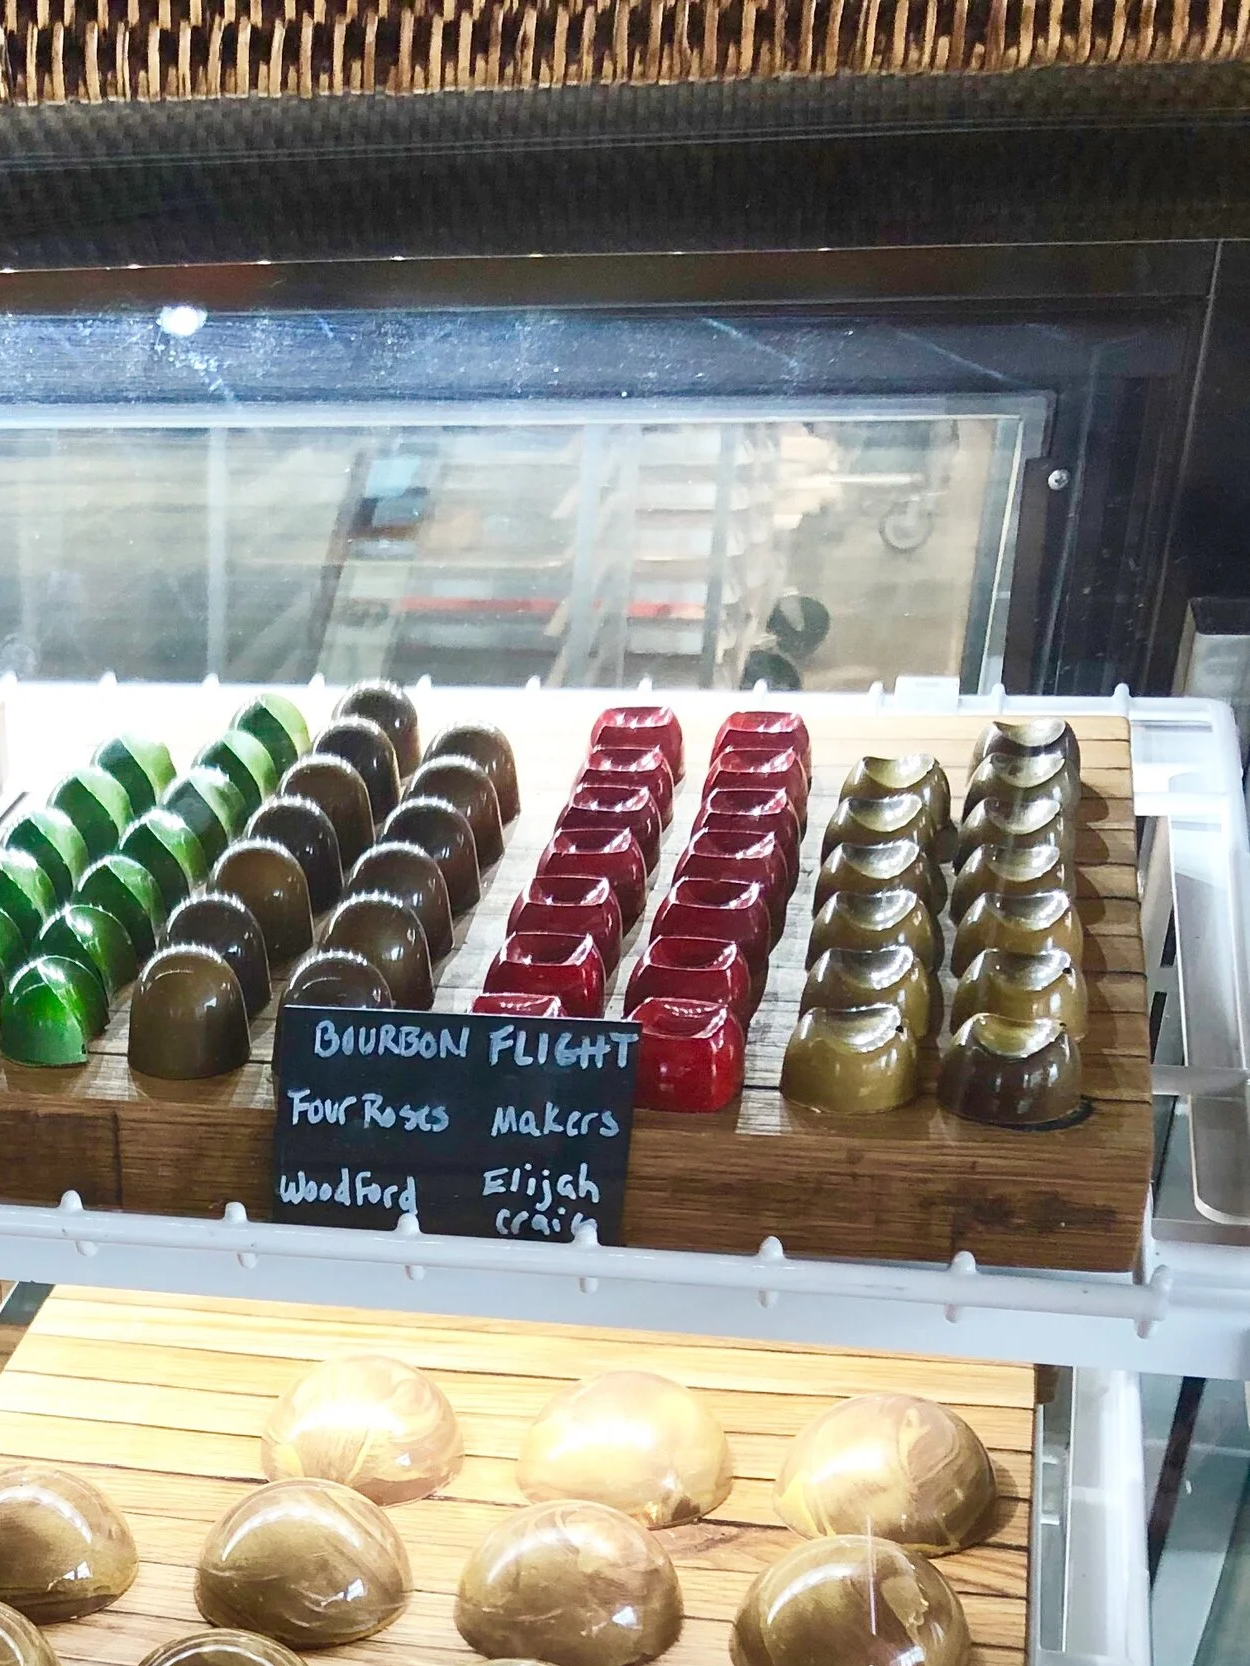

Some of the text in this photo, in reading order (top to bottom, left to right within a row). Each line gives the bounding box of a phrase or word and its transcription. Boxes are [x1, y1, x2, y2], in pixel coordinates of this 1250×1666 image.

[488, 1024, 640, 1069] FLIGHT
[286, 1088, 450, 1133] Four Roses
[490, 1102, 620, 1138] Makers
[482, 1162, 600, 1212] Elijah
